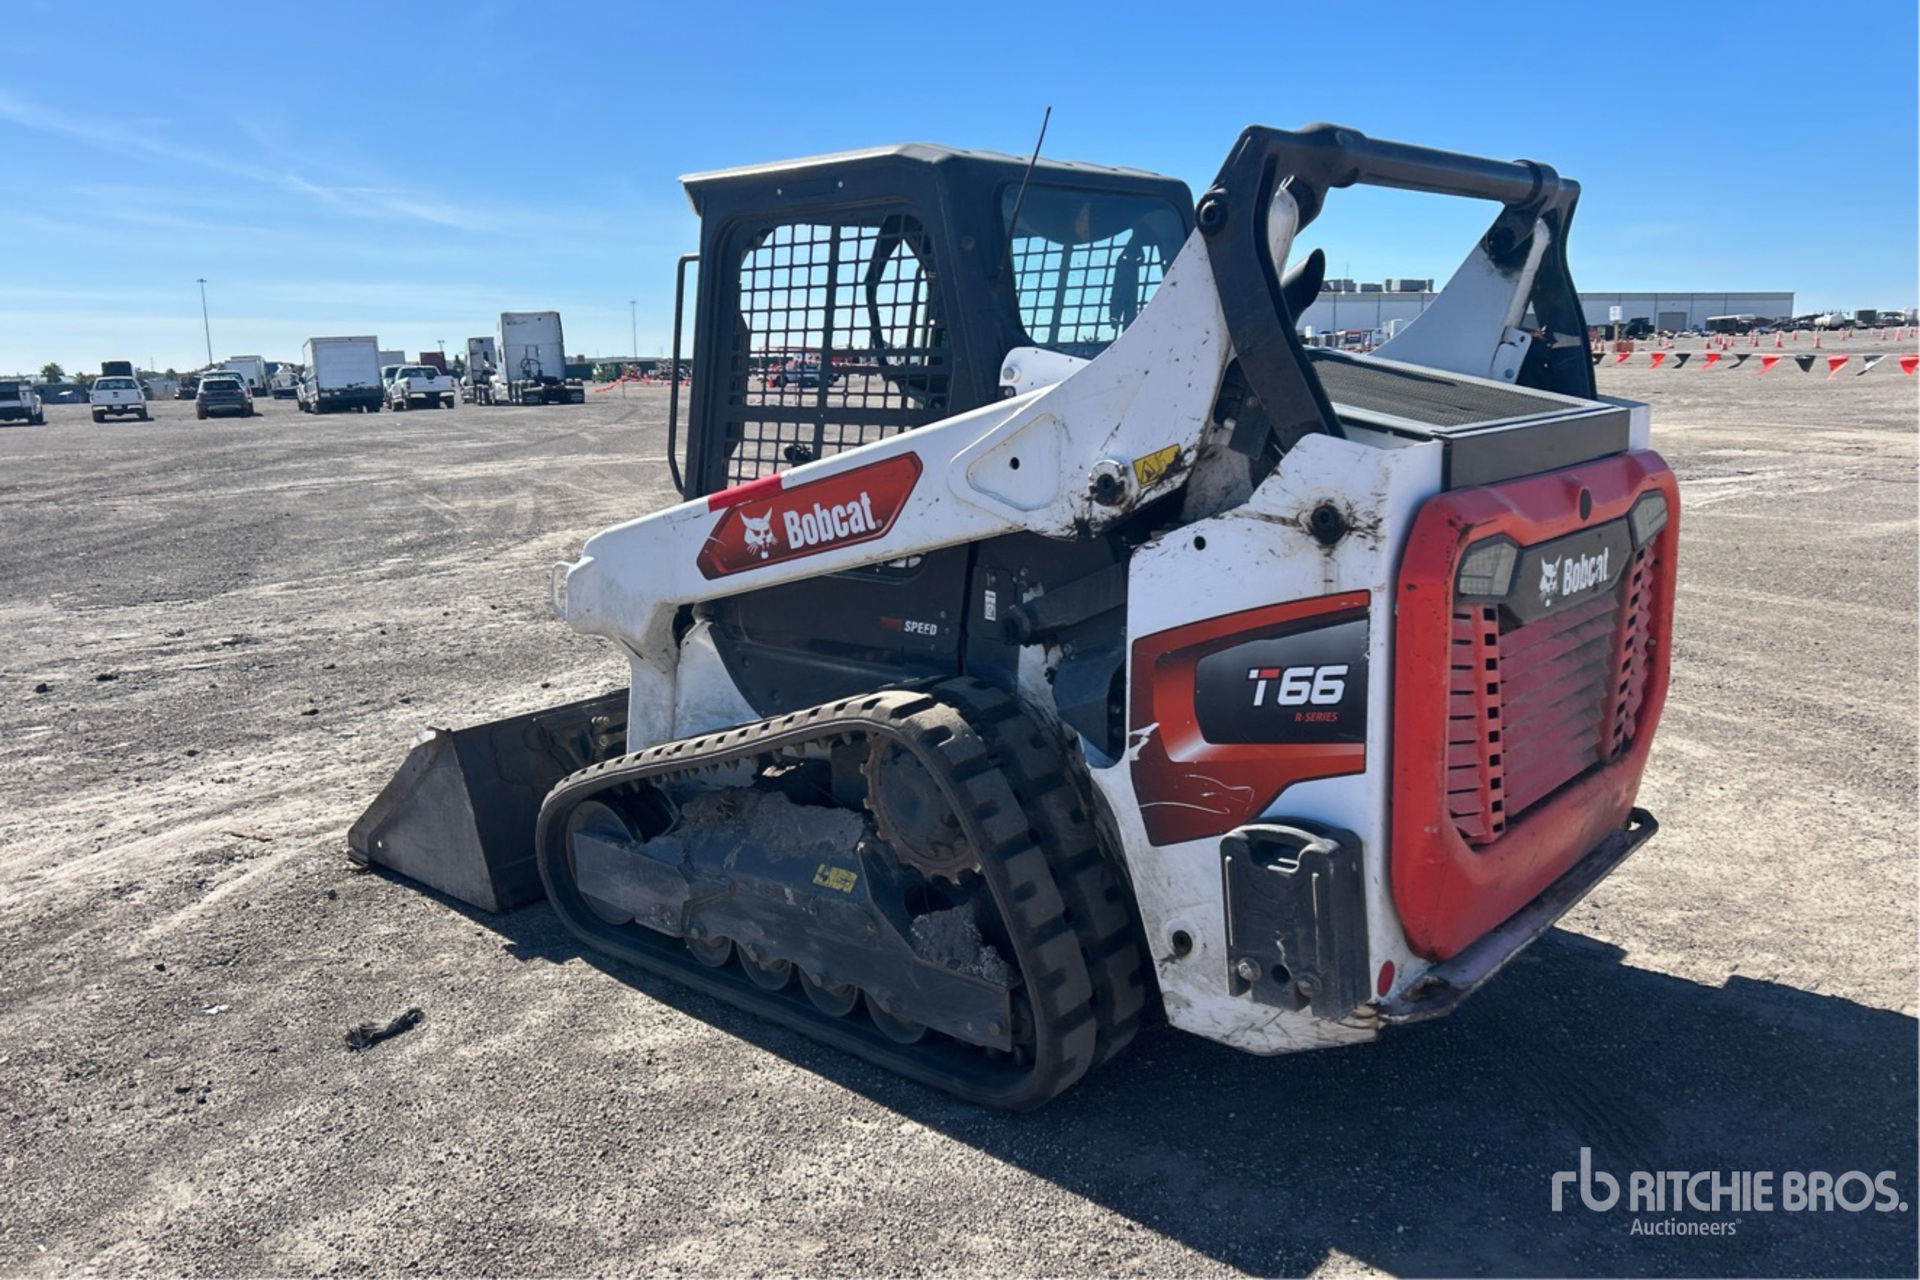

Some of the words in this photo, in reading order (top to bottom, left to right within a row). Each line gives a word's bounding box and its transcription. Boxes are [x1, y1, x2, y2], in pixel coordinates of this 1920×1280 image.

[783, 491, 876, 550] Bobcat
[1562, 547, 1609, 596] Bobcat
[904, 620, 938, 636] SPEED
[1247, 664, 1349, 707] T66
[1294, 711, 1338, 722] R-SERIES
